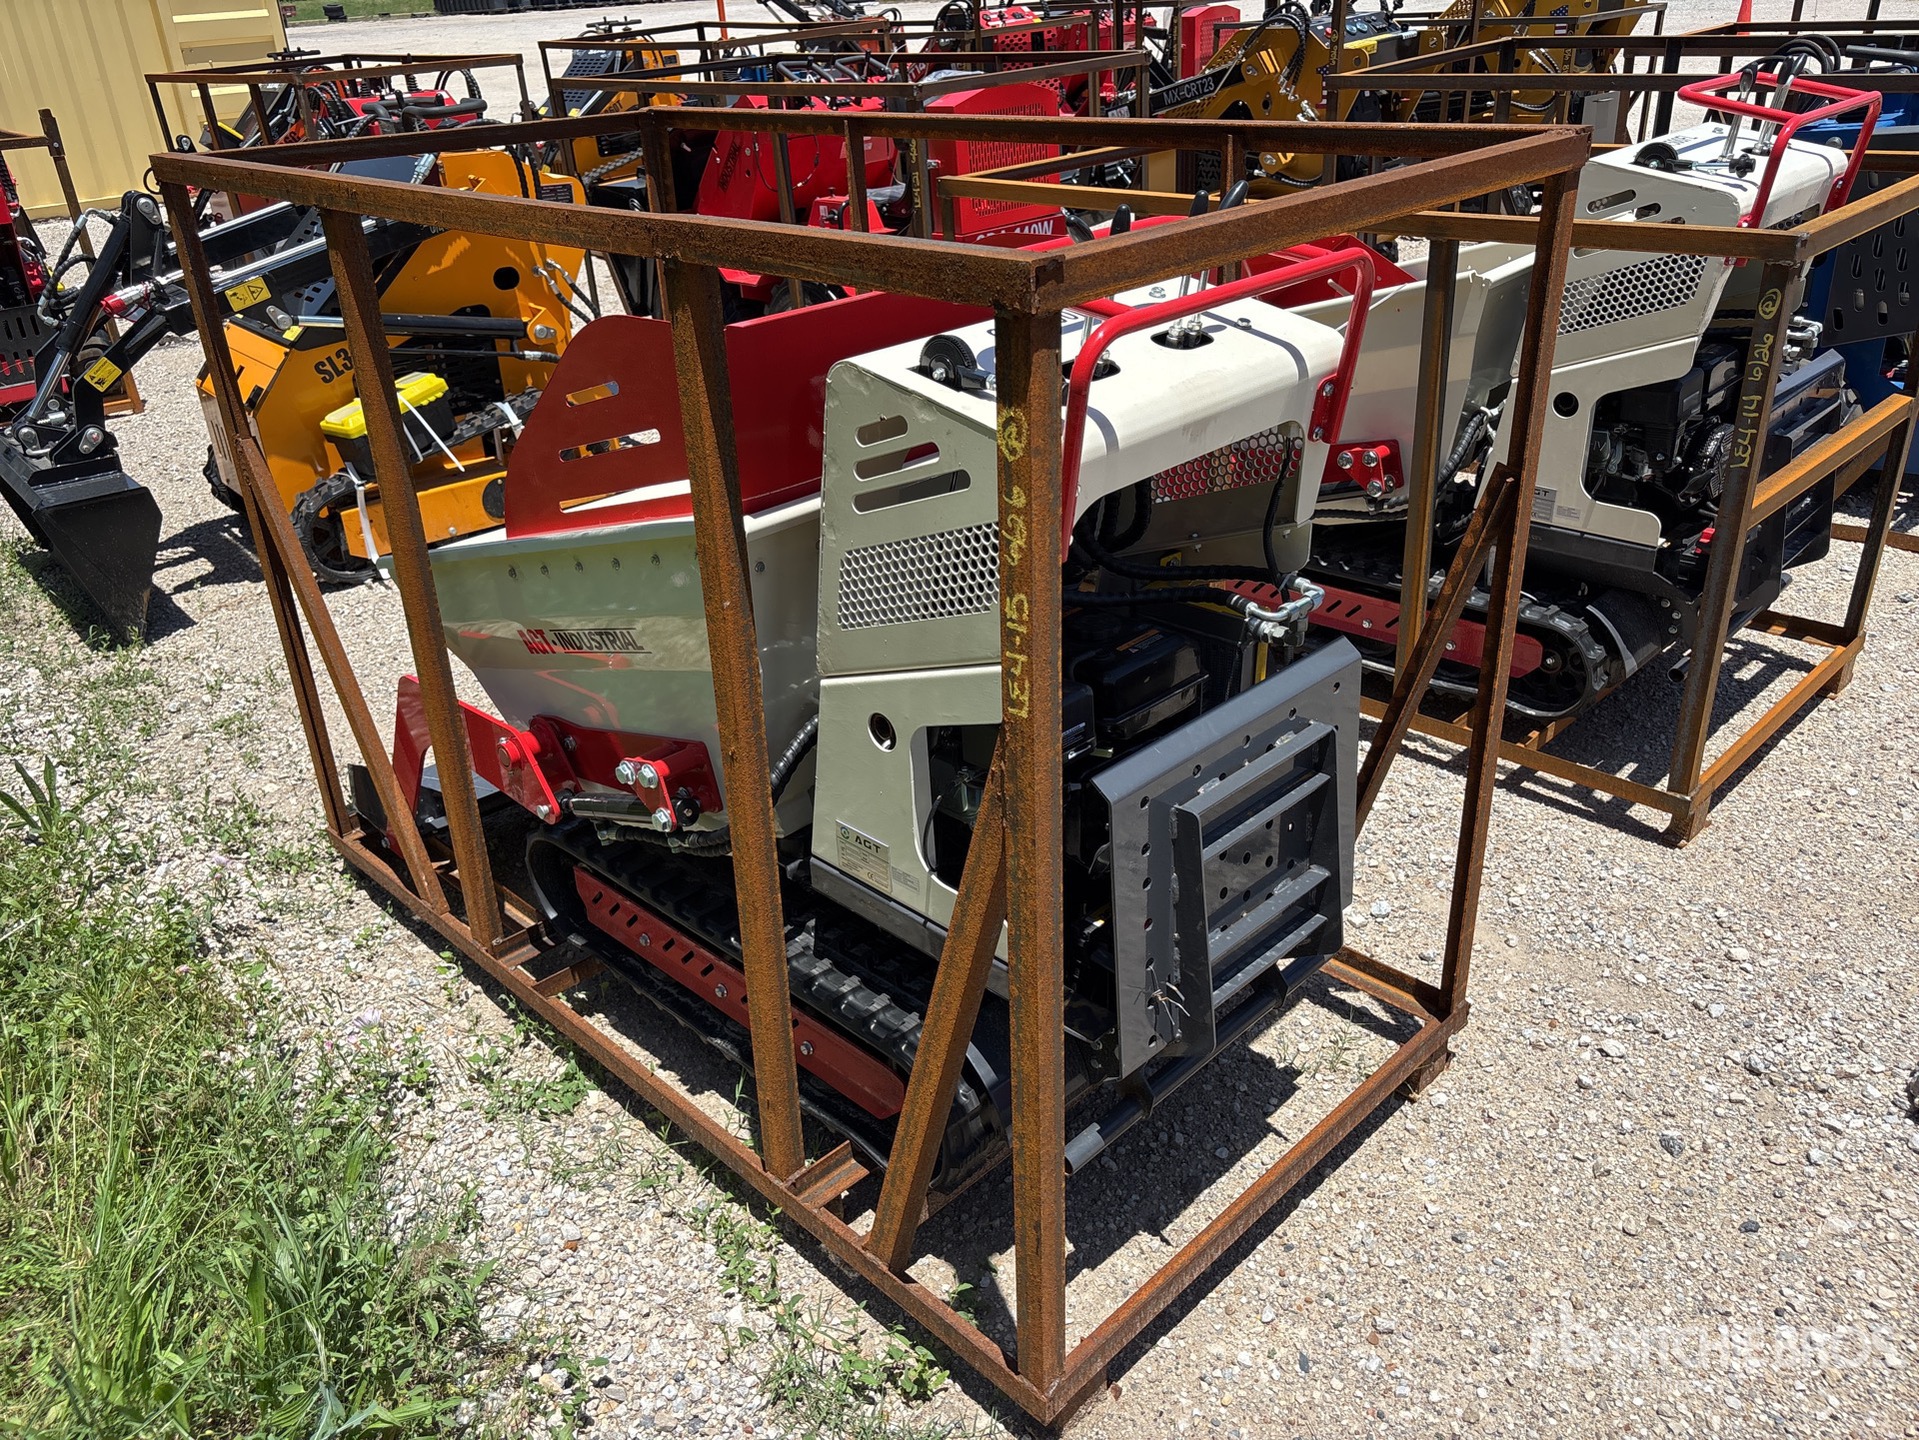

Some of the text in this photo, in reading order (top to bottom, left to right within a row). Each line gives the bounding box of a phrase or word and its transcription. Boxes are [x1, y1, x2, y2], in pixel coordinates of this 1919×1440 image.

[1729, 395, 1762, 469] LE4-14
[1747, 333, 1774, 382] 6/26
[516, 628, 645, 655] AGT INDUSTRIAL
[1005, 593, 1030, 719] LE4-15
[855, 835, 881, 853] AGT
